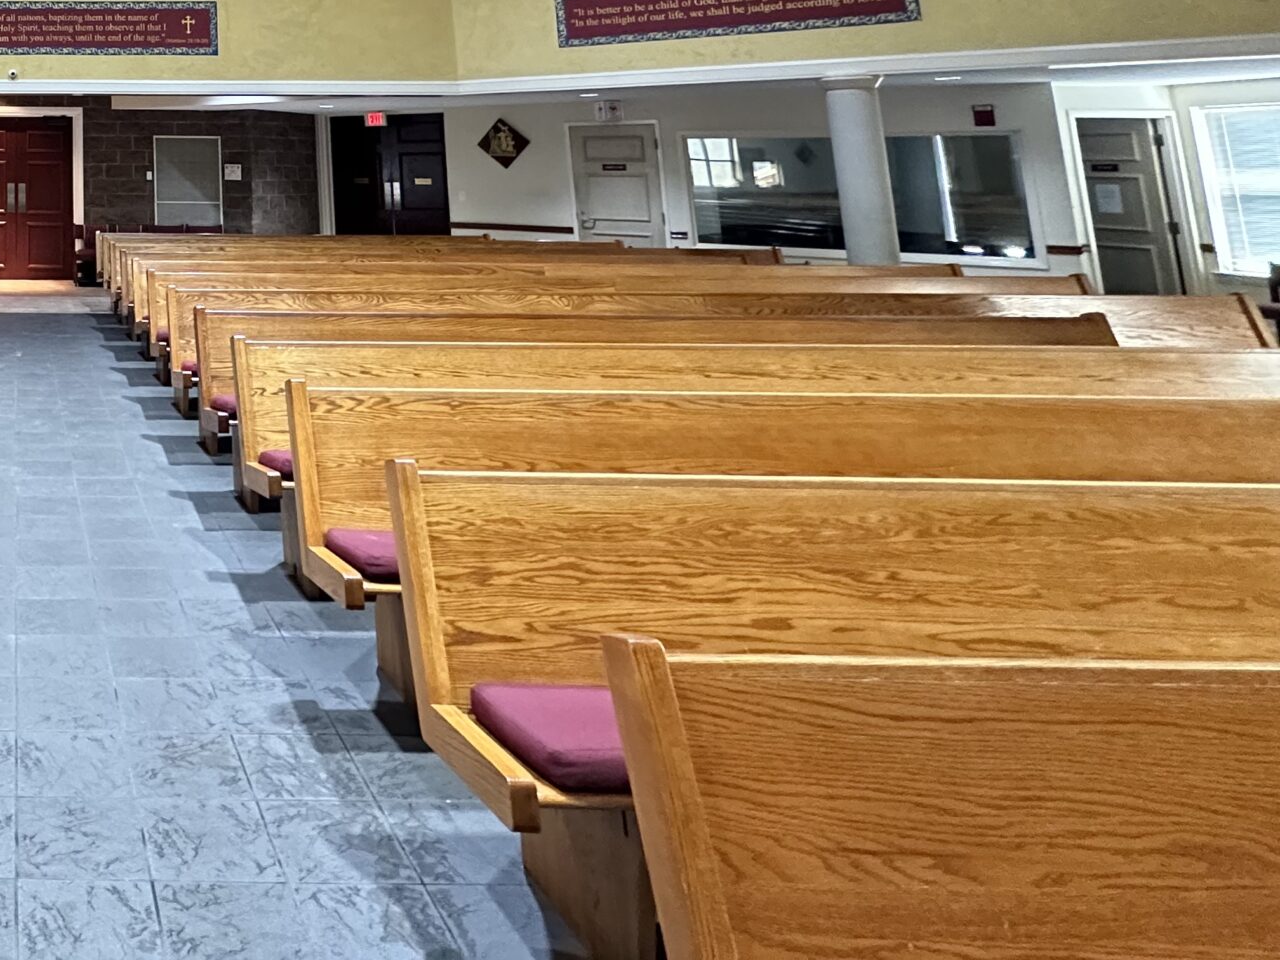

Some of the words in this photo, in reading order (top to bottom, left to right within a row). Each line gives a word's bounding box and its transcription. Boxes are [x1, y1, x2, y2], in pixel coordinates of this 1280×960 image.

[634, 4, 645, 12] be
[655, 0, 678, 10] child
[48, 13, 82, 23] baptizing
[149, 13, 159, 21] of
[602, 15, 636, 25] twilight
[638, 14, 649, 22] of
[706, 6, 730, 16] shall
[732, 5, 744, 14] be
[746, 1, 783, 15] judged
[42, 24, 74, 33] teaching
[104, 22, 134, 32] observe
[136, 23, 146, 31] all
[147, 23, 162, 31] that
